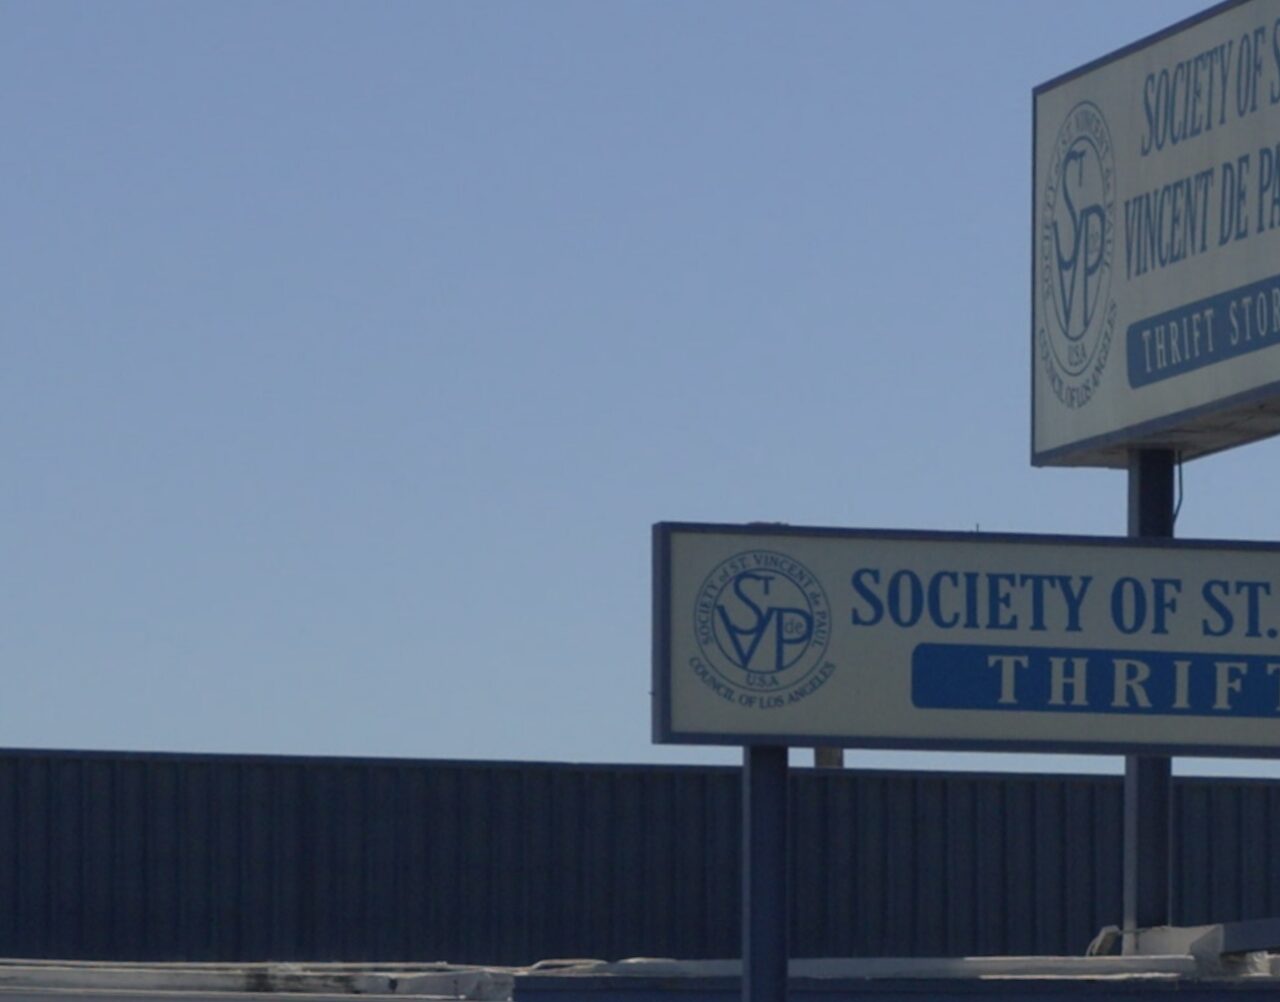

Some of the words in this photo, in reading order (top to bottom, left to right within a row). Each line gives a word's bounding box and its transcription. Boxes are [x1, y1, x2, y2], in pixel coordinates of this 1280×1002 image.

[1141, 40, 1233, 157] SOCIETY
[1236, 26, 1266, 118] OF
[1124, 167, 1214, 281] VINCENT
[1218, 153, 1250, 247] DE
[1142, 307, 1214, 374] THRIFT
[753, 553, 814, 589] VINCENT
[850, 568, 1094, 632] SOCIETY
[1110, 576, 1183, 636] OF
[1201, 579, 1278, 640] ST.
[689, 657, 735, 703] COUNCIL
[788, 661, 837, 704] ANGELES
